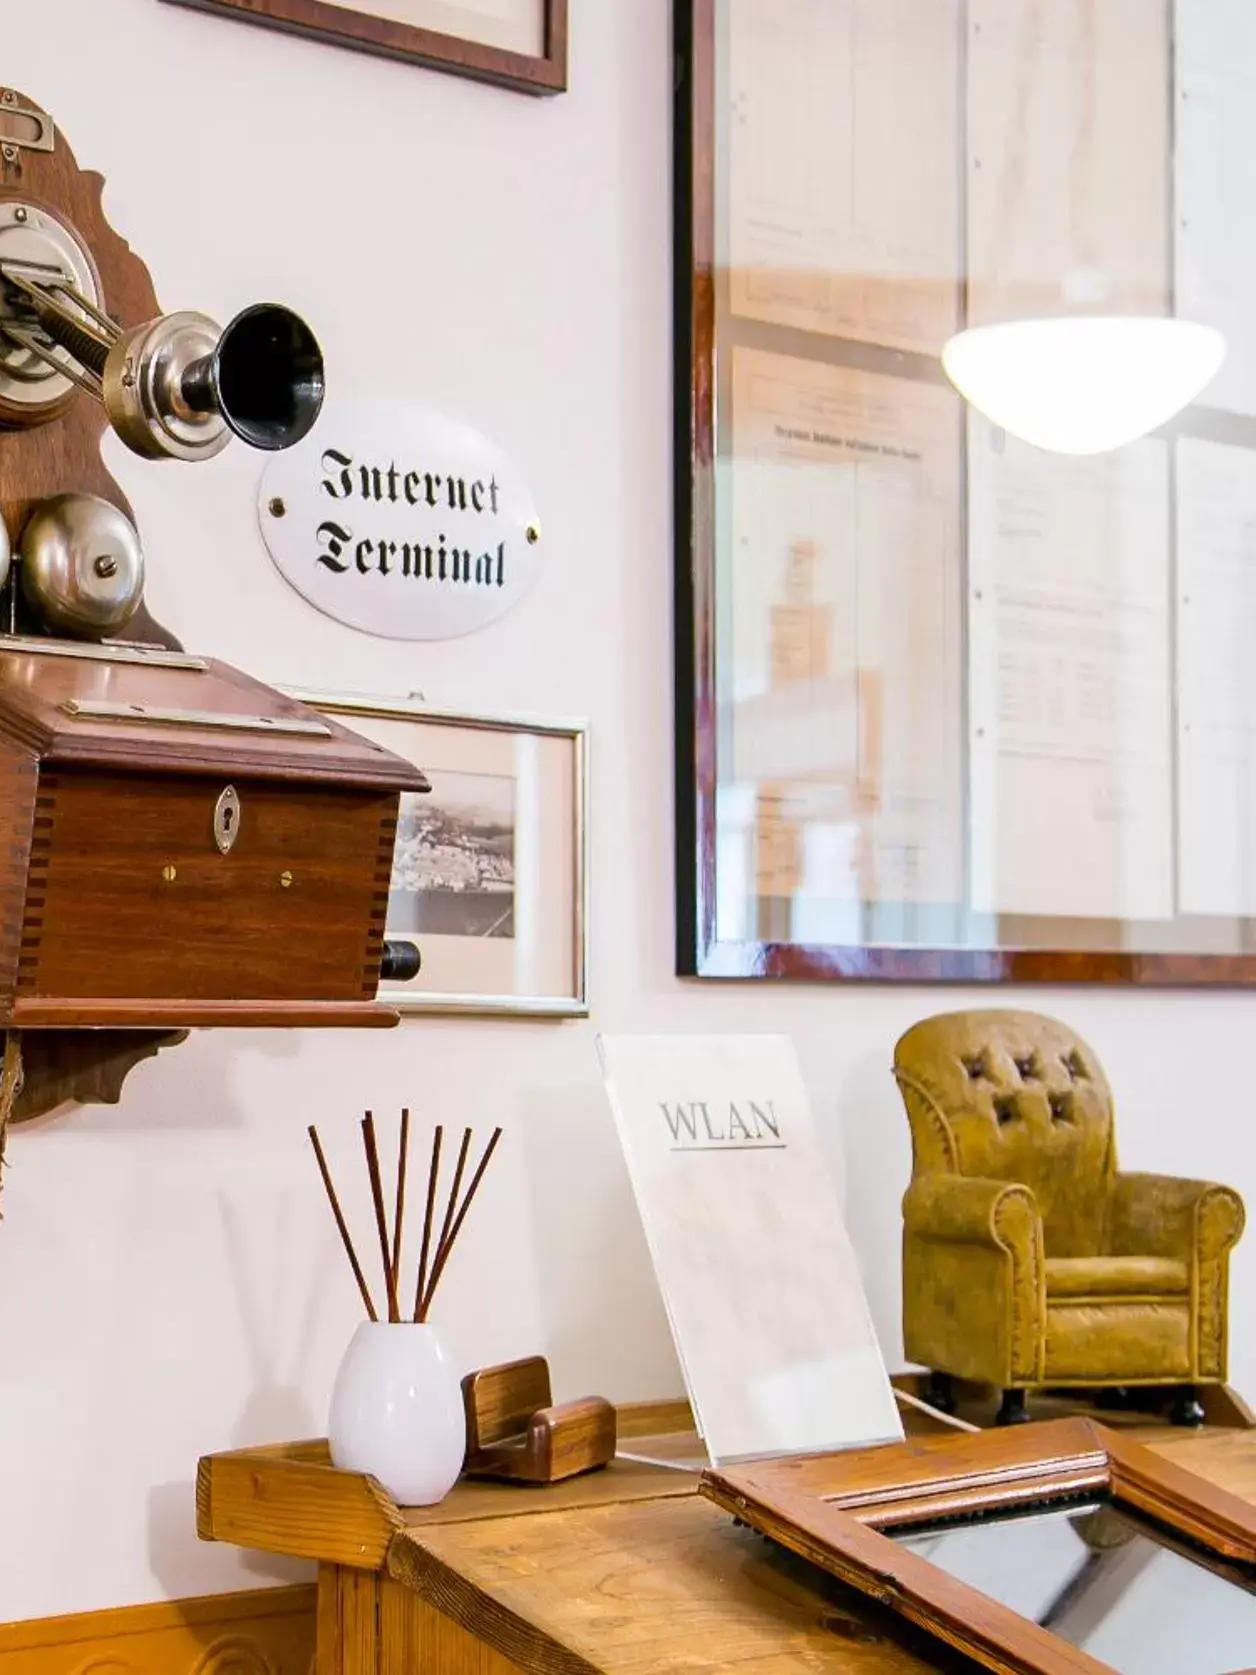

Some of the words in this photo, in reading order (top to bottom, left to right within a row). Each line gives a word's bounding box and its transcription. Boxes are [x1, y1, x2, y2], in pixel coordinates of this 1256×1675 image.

[320, 448, 500, 515] Internet
[315, 520, 505, 588] Terminal
[659, 1101, 782, 1141] WLAN
